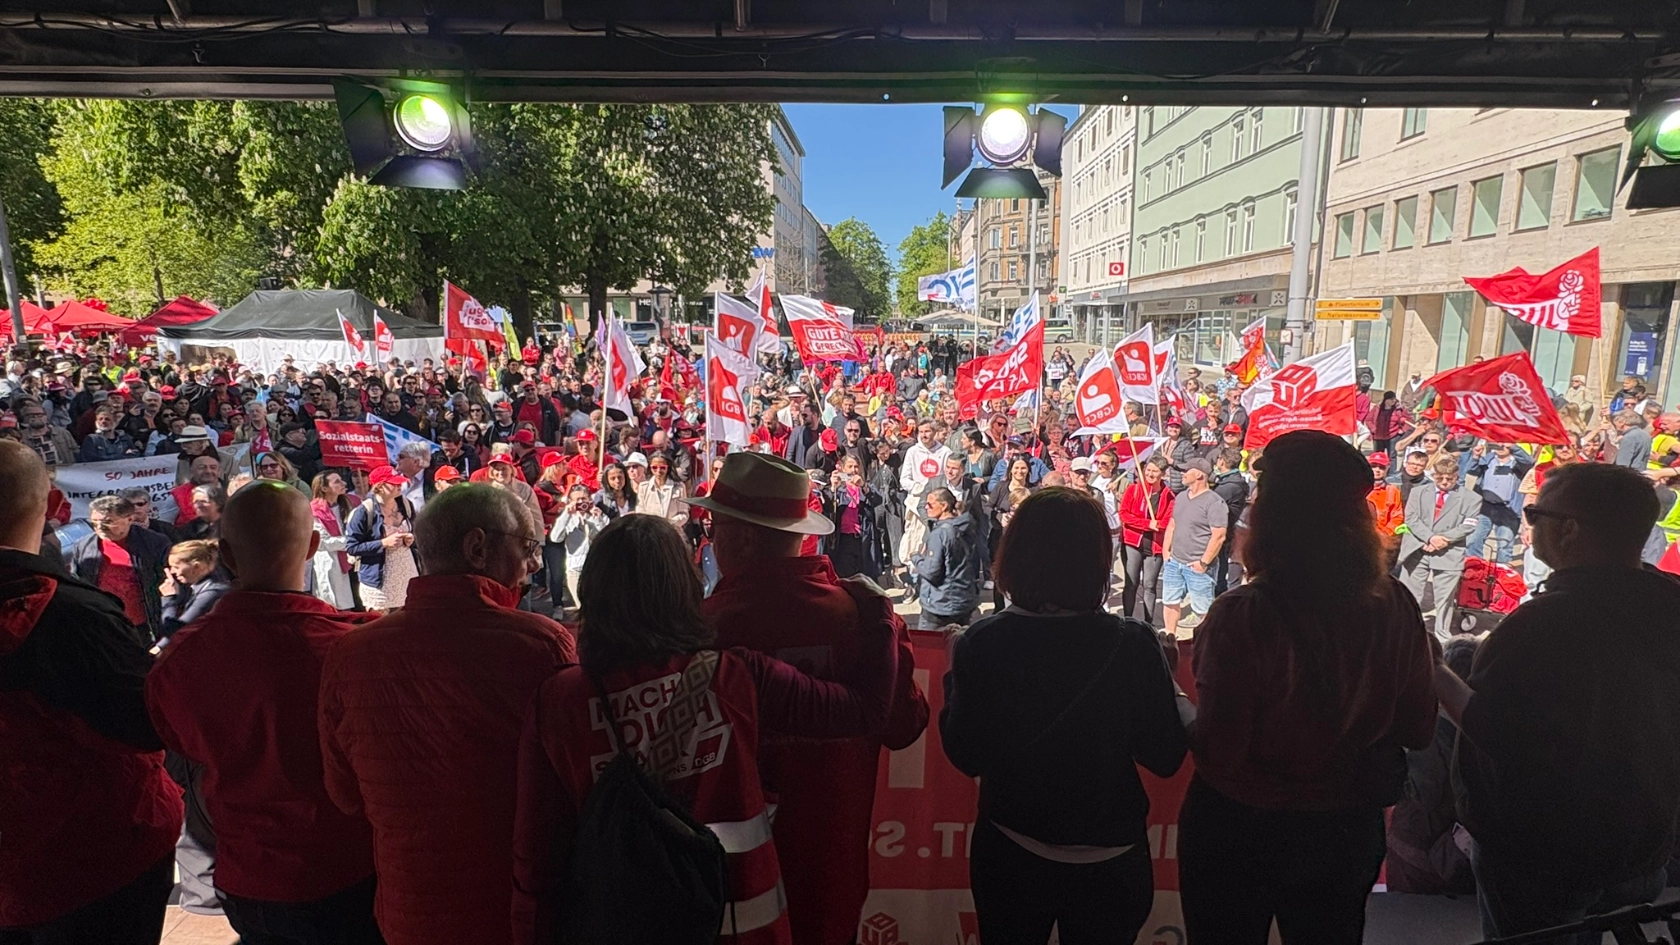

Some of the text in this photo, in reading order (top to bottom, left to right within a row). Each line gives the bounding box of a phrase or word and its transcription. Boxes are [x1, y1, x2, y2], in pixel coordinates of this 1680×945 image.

[808, 327, 839, 340] GUTE
[319, 431, 383, 443] Sozialstaats-
[334, 444, 374, 454] retterin
[105, 467, 171, 481] 50 JAHRE
